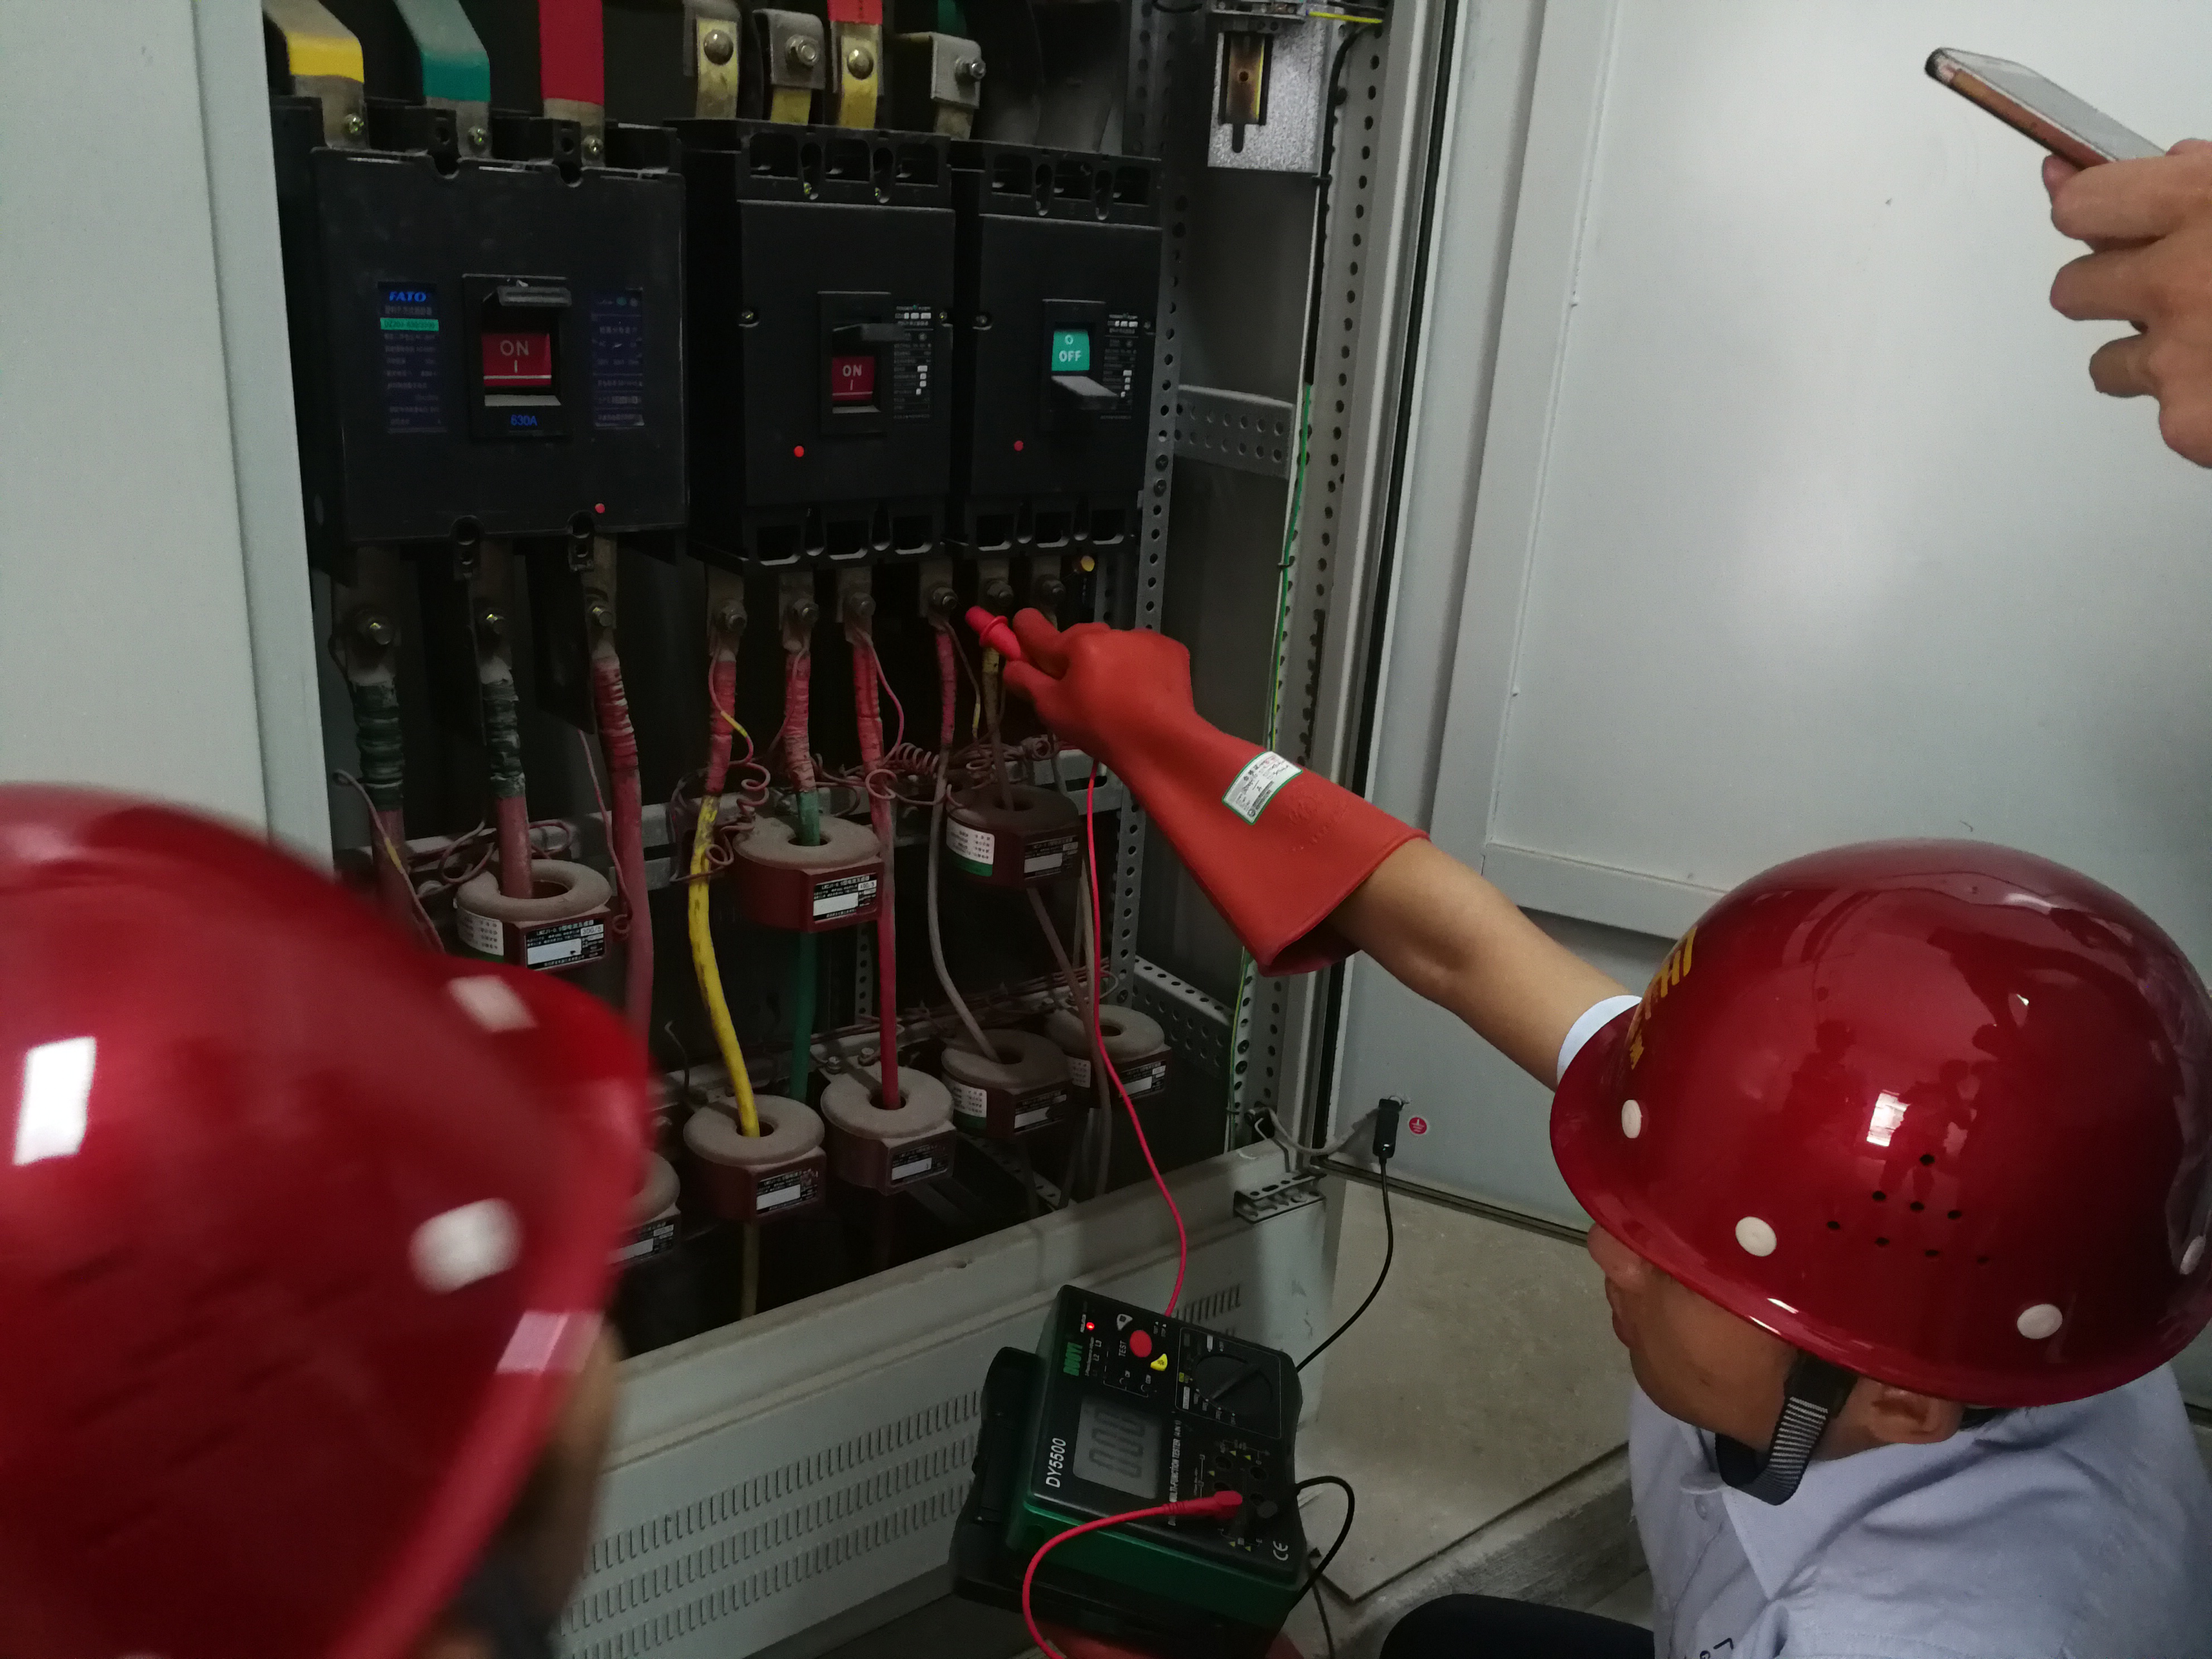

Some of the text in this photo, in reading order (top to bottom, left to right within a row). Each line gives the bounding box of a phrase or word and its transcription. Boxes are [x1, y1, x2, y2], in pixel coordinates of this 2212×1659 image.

[389, 291, 426, 302] FATO
[500, 340, 530, 356] ON
[1059, 350, 1081, 362] OFF
[842, 364, 862, 377] ON
[511, 414, 538, 426] 630A
[1118, 1340, 1127, 1357] TEST
[1171, 1438, 1181, 1459] TESTER
[1046, 1437, 1066, 1488] DY5500
